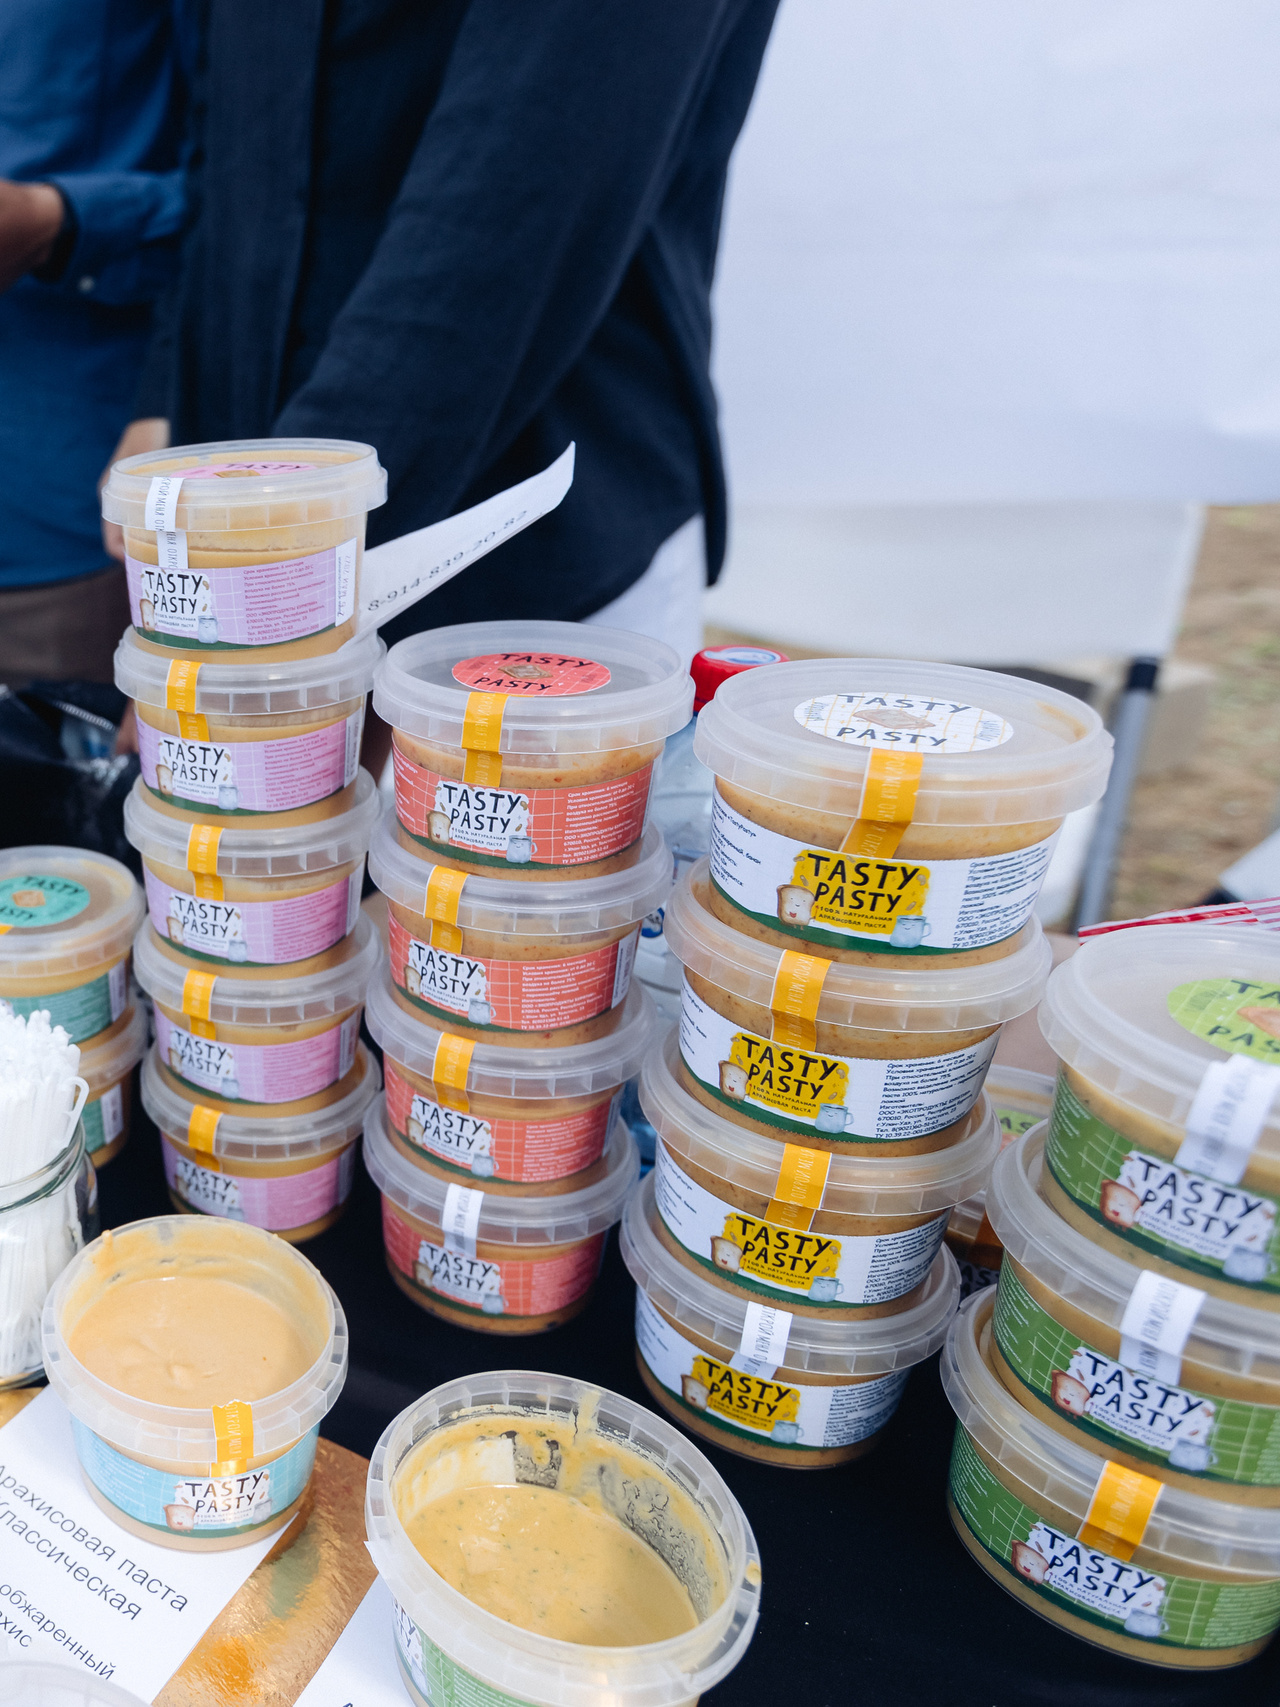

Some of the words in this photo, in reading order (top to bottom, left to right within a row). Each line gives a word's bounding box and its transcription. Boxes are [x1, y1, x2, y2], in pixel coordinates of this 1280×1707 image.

[145, 571, 202, 594] TASTY
[153, 594, 197, 614] PASTY
[500, 653, 593, 668] TASTY
[474, 677, 552, 691] PASTY
[837, 694, 972, 713] TASTY
[837, 727, 947, 747] PASTY
[164, 740, 224, 765] TASTY
[172, 761, 218, 783] PASTY
[443, 784, 522, 814] TASTY
[450, 809, 510, 834] PASTY
[808, 853, 920, 891] TASTY
[175, 895, 234, 922] TASTY
[814, 881, 902, 913] PASTY
[183, 915, 228, 938] PASTY
[414, 943, 478, 979] TASTY
[421, 966, 470, 996] PASTY
[175, 1030, 226, 1056] TASTY
[742, 1036, 839, 1080] TASTY
[181, 1053, 221, 1074] PASTY
[748, 1063, 824, 1100] PASTY
[418, 1100, 484, 1135] TASTY
[424, 1120, 474, 1150] PASTY
[182, 1161, 232, 1191] TASTY
[1137, 1156, 1263, 1217] TASTY
[1140, 1189, 1240, 1239] PASTY
[736, 1215, 832, 1257] TASTY
[426, 1245, 492, 1276] TASTY
[742, 1240, 817, 1274] PASTY
[433, 1265, 484, 1290] PASTY
[702, 1358, 792, 1403] TASTY
[1086, 1352, 1204, 1416] TASTY
[708, 1382, 778, 1417] PASTY
[1089, 1382, 1183, 1432] PASTY
[185, 1472, 264, 1497] TASTY
[195, 1492, 255, 1512] PASTY
[1043, 1527, 1155, 1589] TASTY
[117, 1558, 189, 1612] паста
[1049, 1556, 1136, 1603] PASTY
